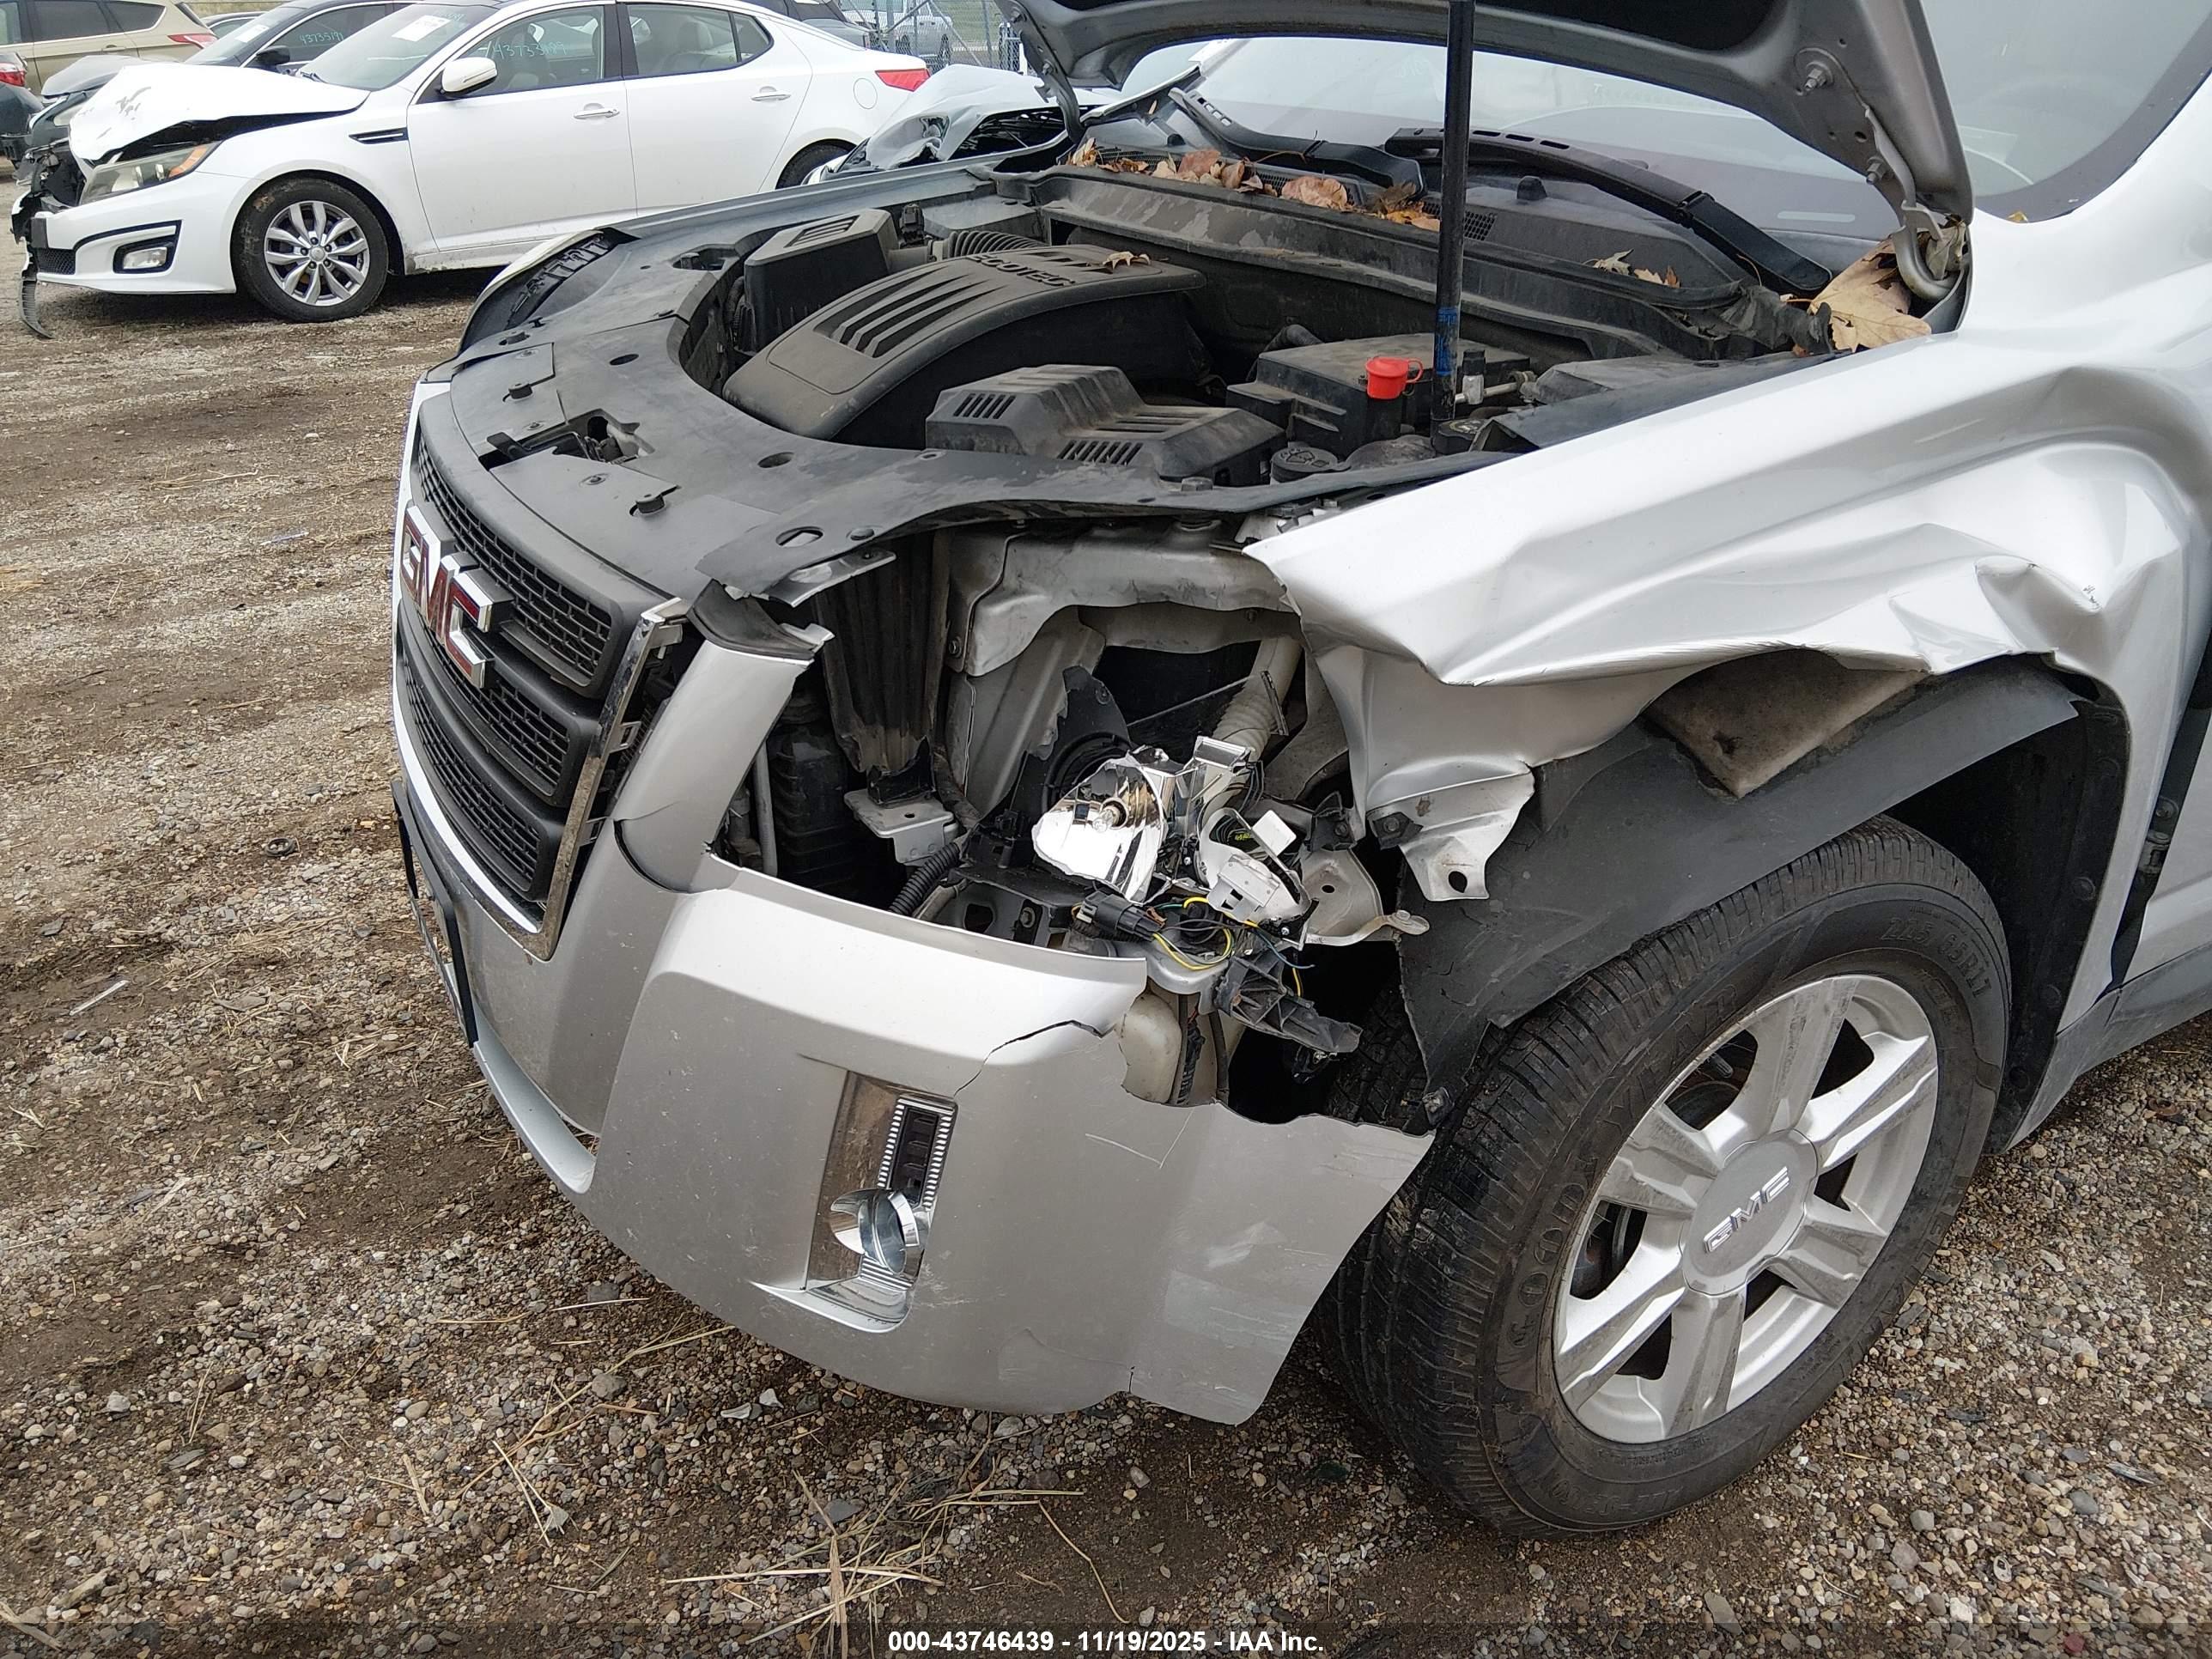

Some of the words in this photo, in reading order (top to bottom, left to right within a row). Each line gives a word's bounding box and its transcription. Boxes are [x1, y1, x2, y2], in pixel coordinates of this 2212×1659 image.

[963, 253, 1076, 287] ECOTEC
[400, 505, 495, 690] GMC
[1703, 1166, 1790, 1254] GMC
